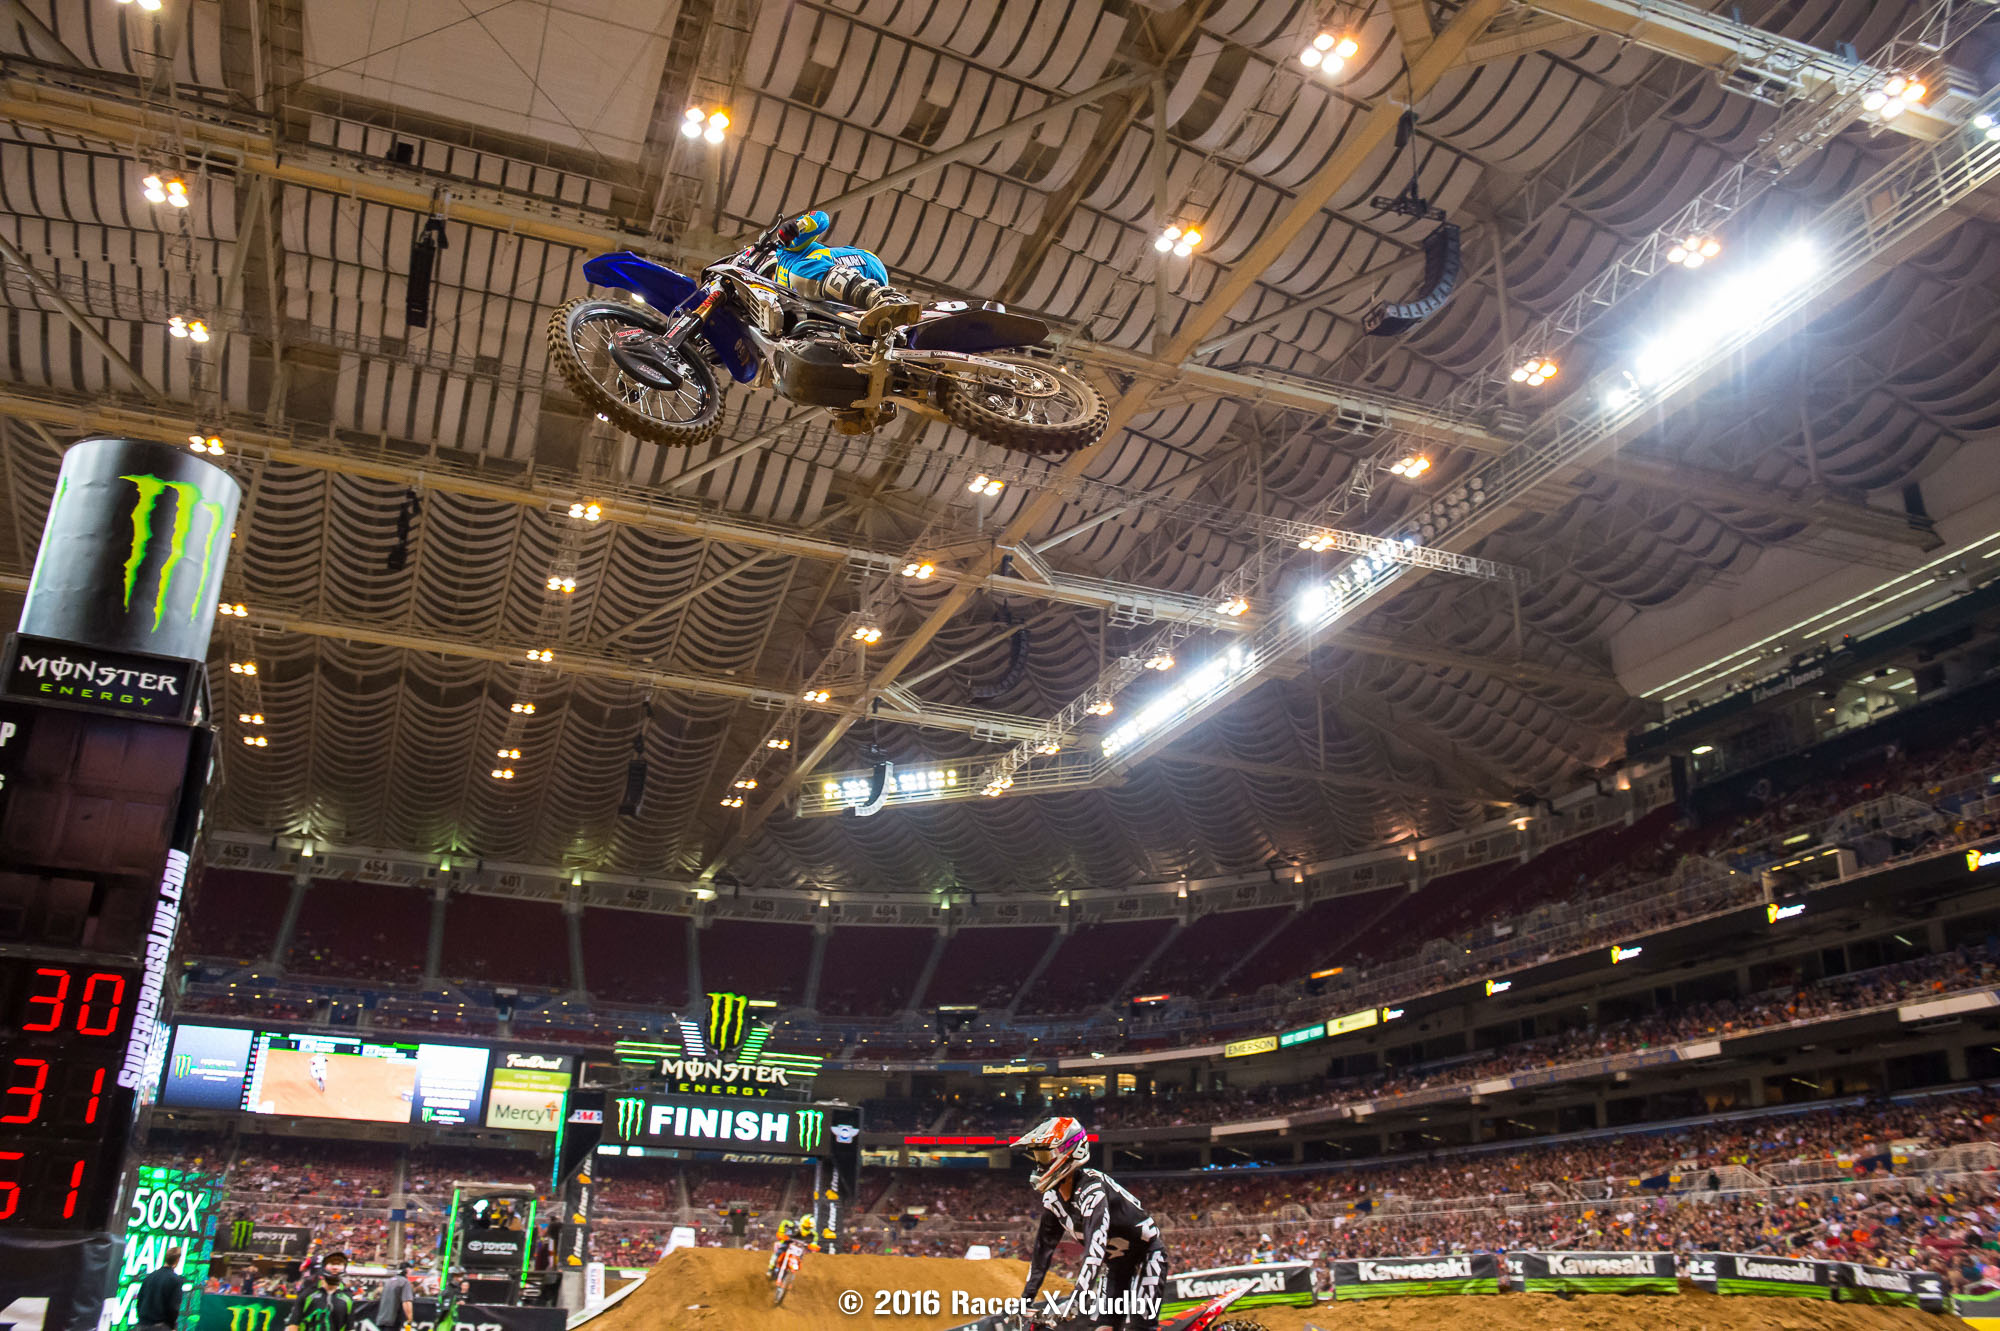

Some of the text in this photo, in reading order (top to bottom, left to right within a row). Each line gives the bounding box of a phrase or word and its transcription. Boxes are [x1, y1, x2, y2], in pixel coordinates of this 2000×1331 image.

[19, 655, 179, 696] MONSTER
[40, 683, 153, 706] ENERGY
[223, 844, 249, 859] 453
[364, 860, 389, 873] 454
[23, 968, 126, 1036] 30
[1228, 1039, 1276, 1056] EMERSON
[661, 1056, 789, 1087] MONSTER
[0, 1058, 106, 1124] 31
[679, 1082, 769, 1098] ENERGY
[495, 1103, 542, 1124] Mercy
[649, 1105, 790, 1143] FINISH
[578, 1186, 589, 1217] thor
[828, 1202, 837, 1232] thor
[482, 1242, 518, 1251] TOYOTA
[573, 1227, 584, 1258] thor
[1357, 1257, 1472, 1282] Kawasaki
[1548, 1254, 1656, 1275] Kawasaki
[1735, 1256, 1816, 1282] Kawasaki
[1853, 1264, 1912, 1292] Kawasaki
[1176, 1271, 1286, 1299] Kawasaki
